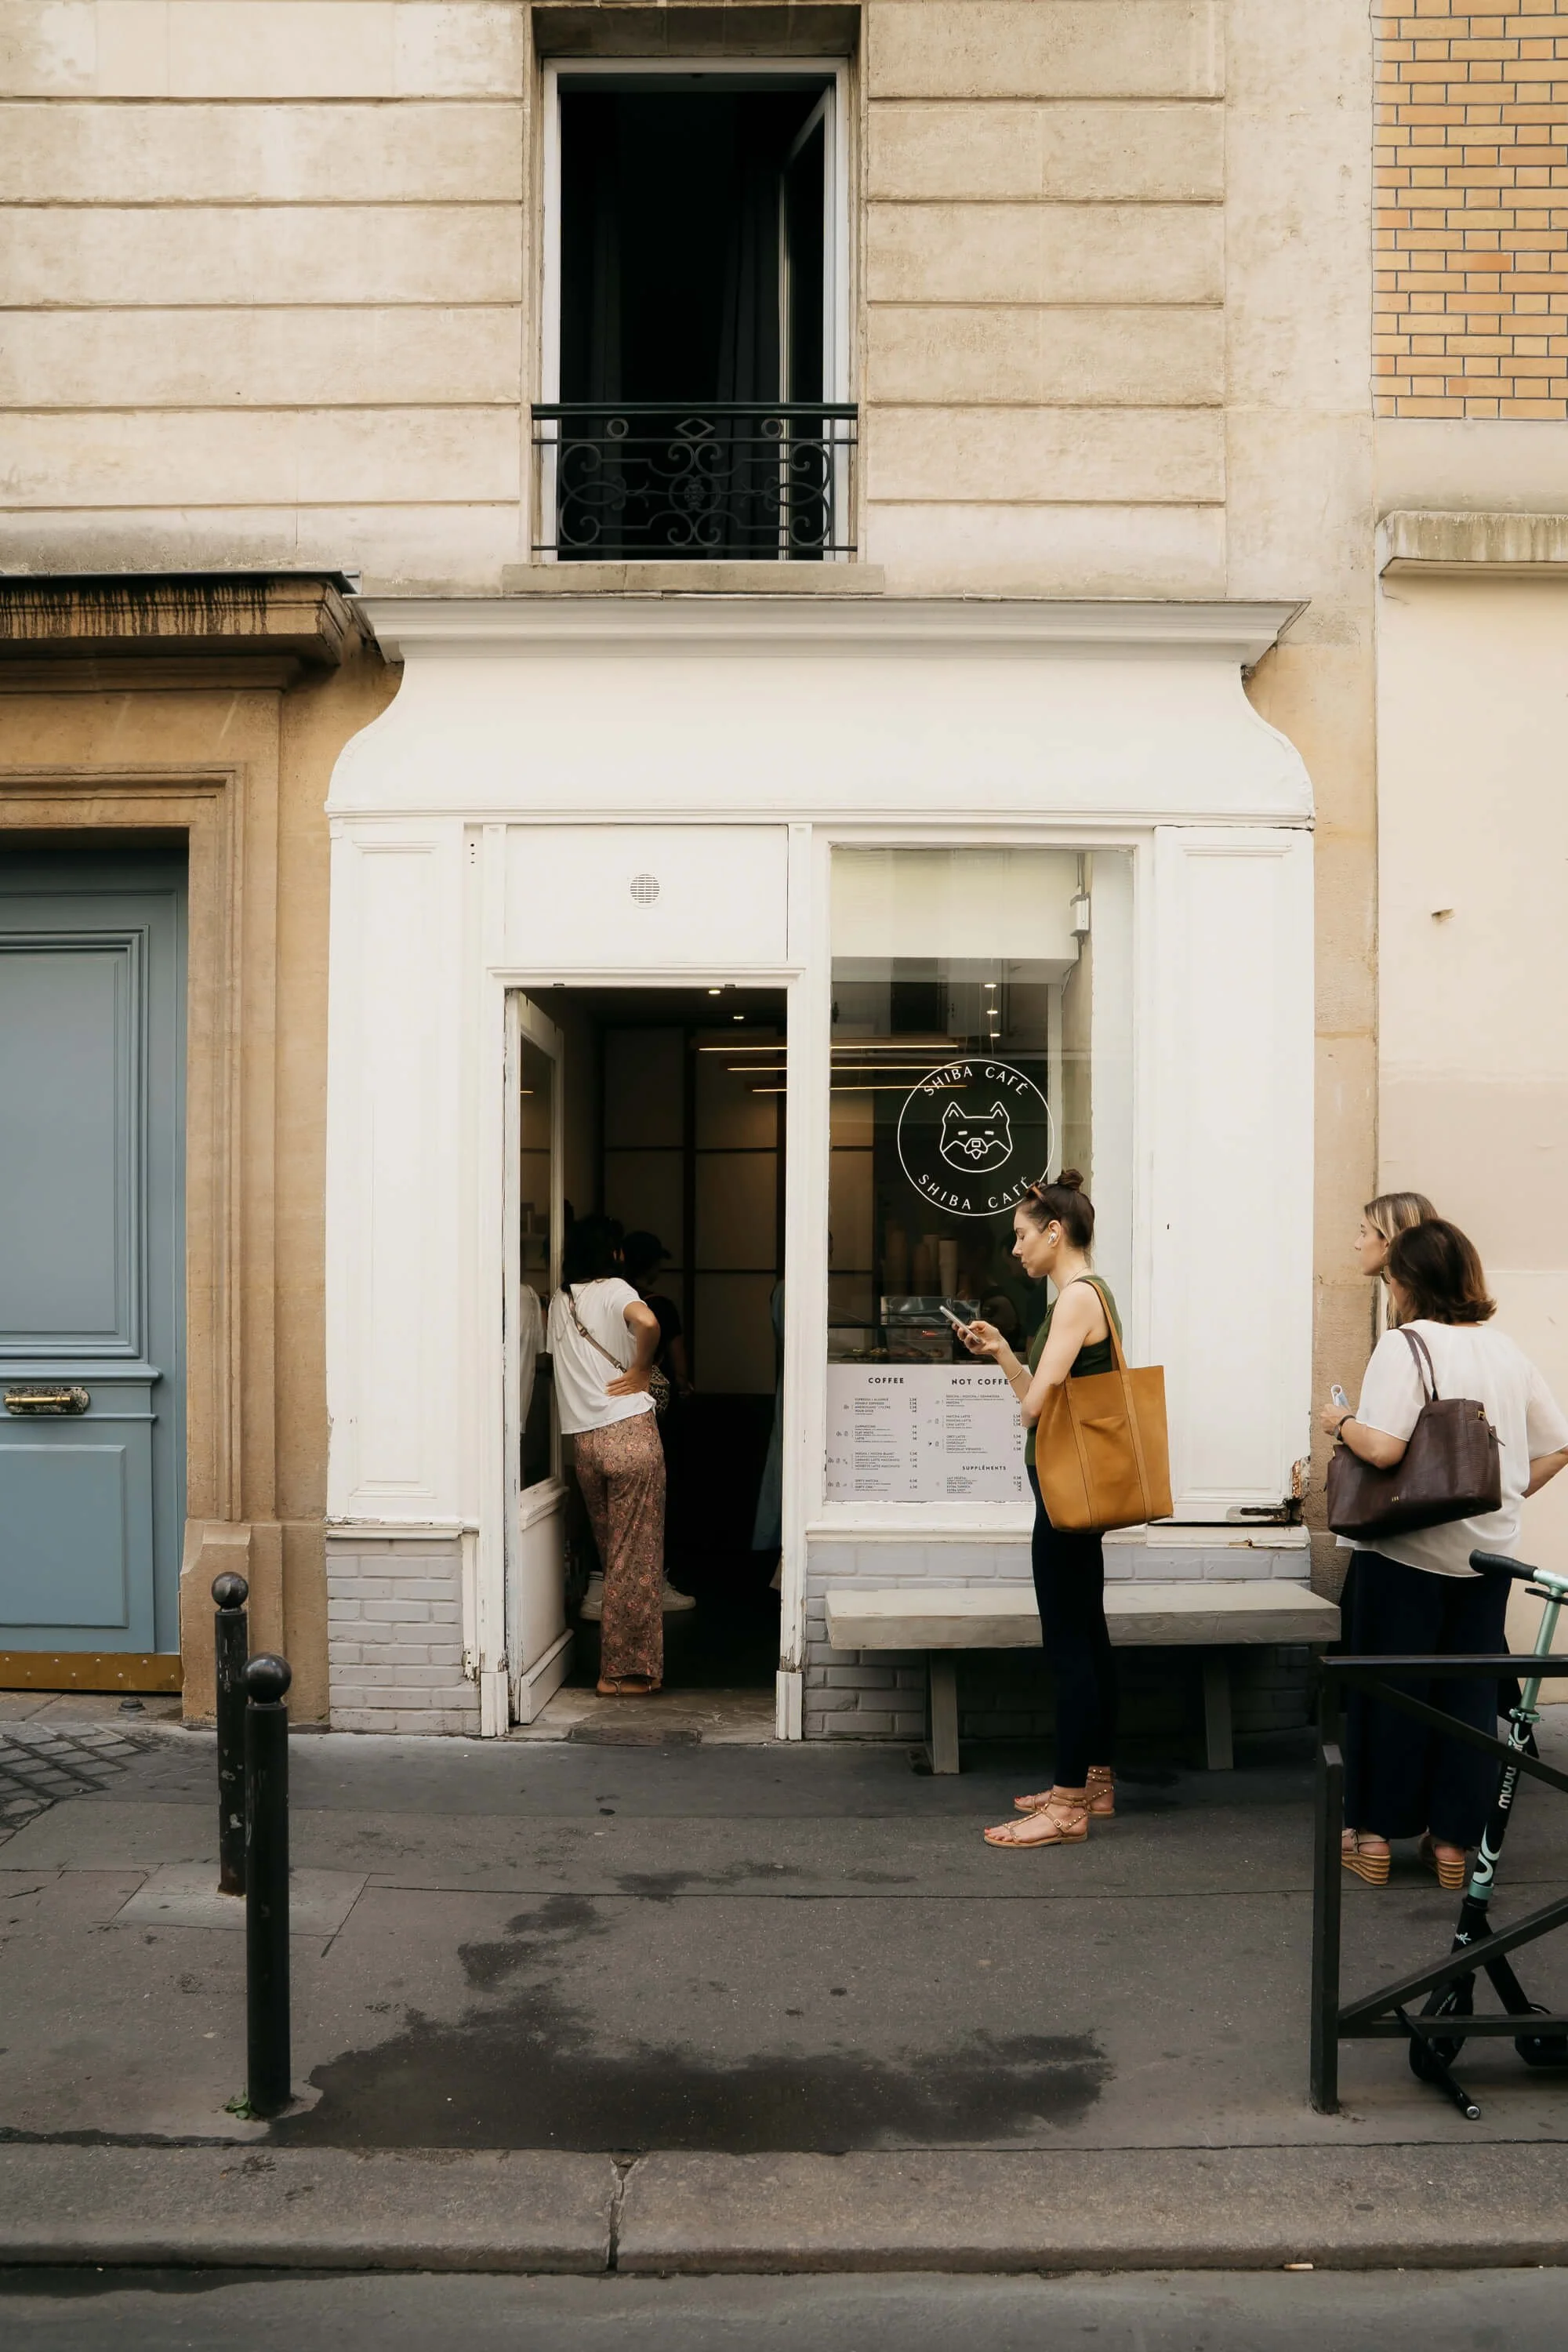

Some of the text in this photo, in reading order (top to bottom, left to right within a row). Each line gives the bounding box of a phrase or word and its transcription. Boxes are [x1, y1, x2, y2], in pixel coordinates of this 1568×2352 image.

[924, 1065, 1029, 1097] SHIBA CAFÉ
[918, 1174, 971, 1210] SHIBA
